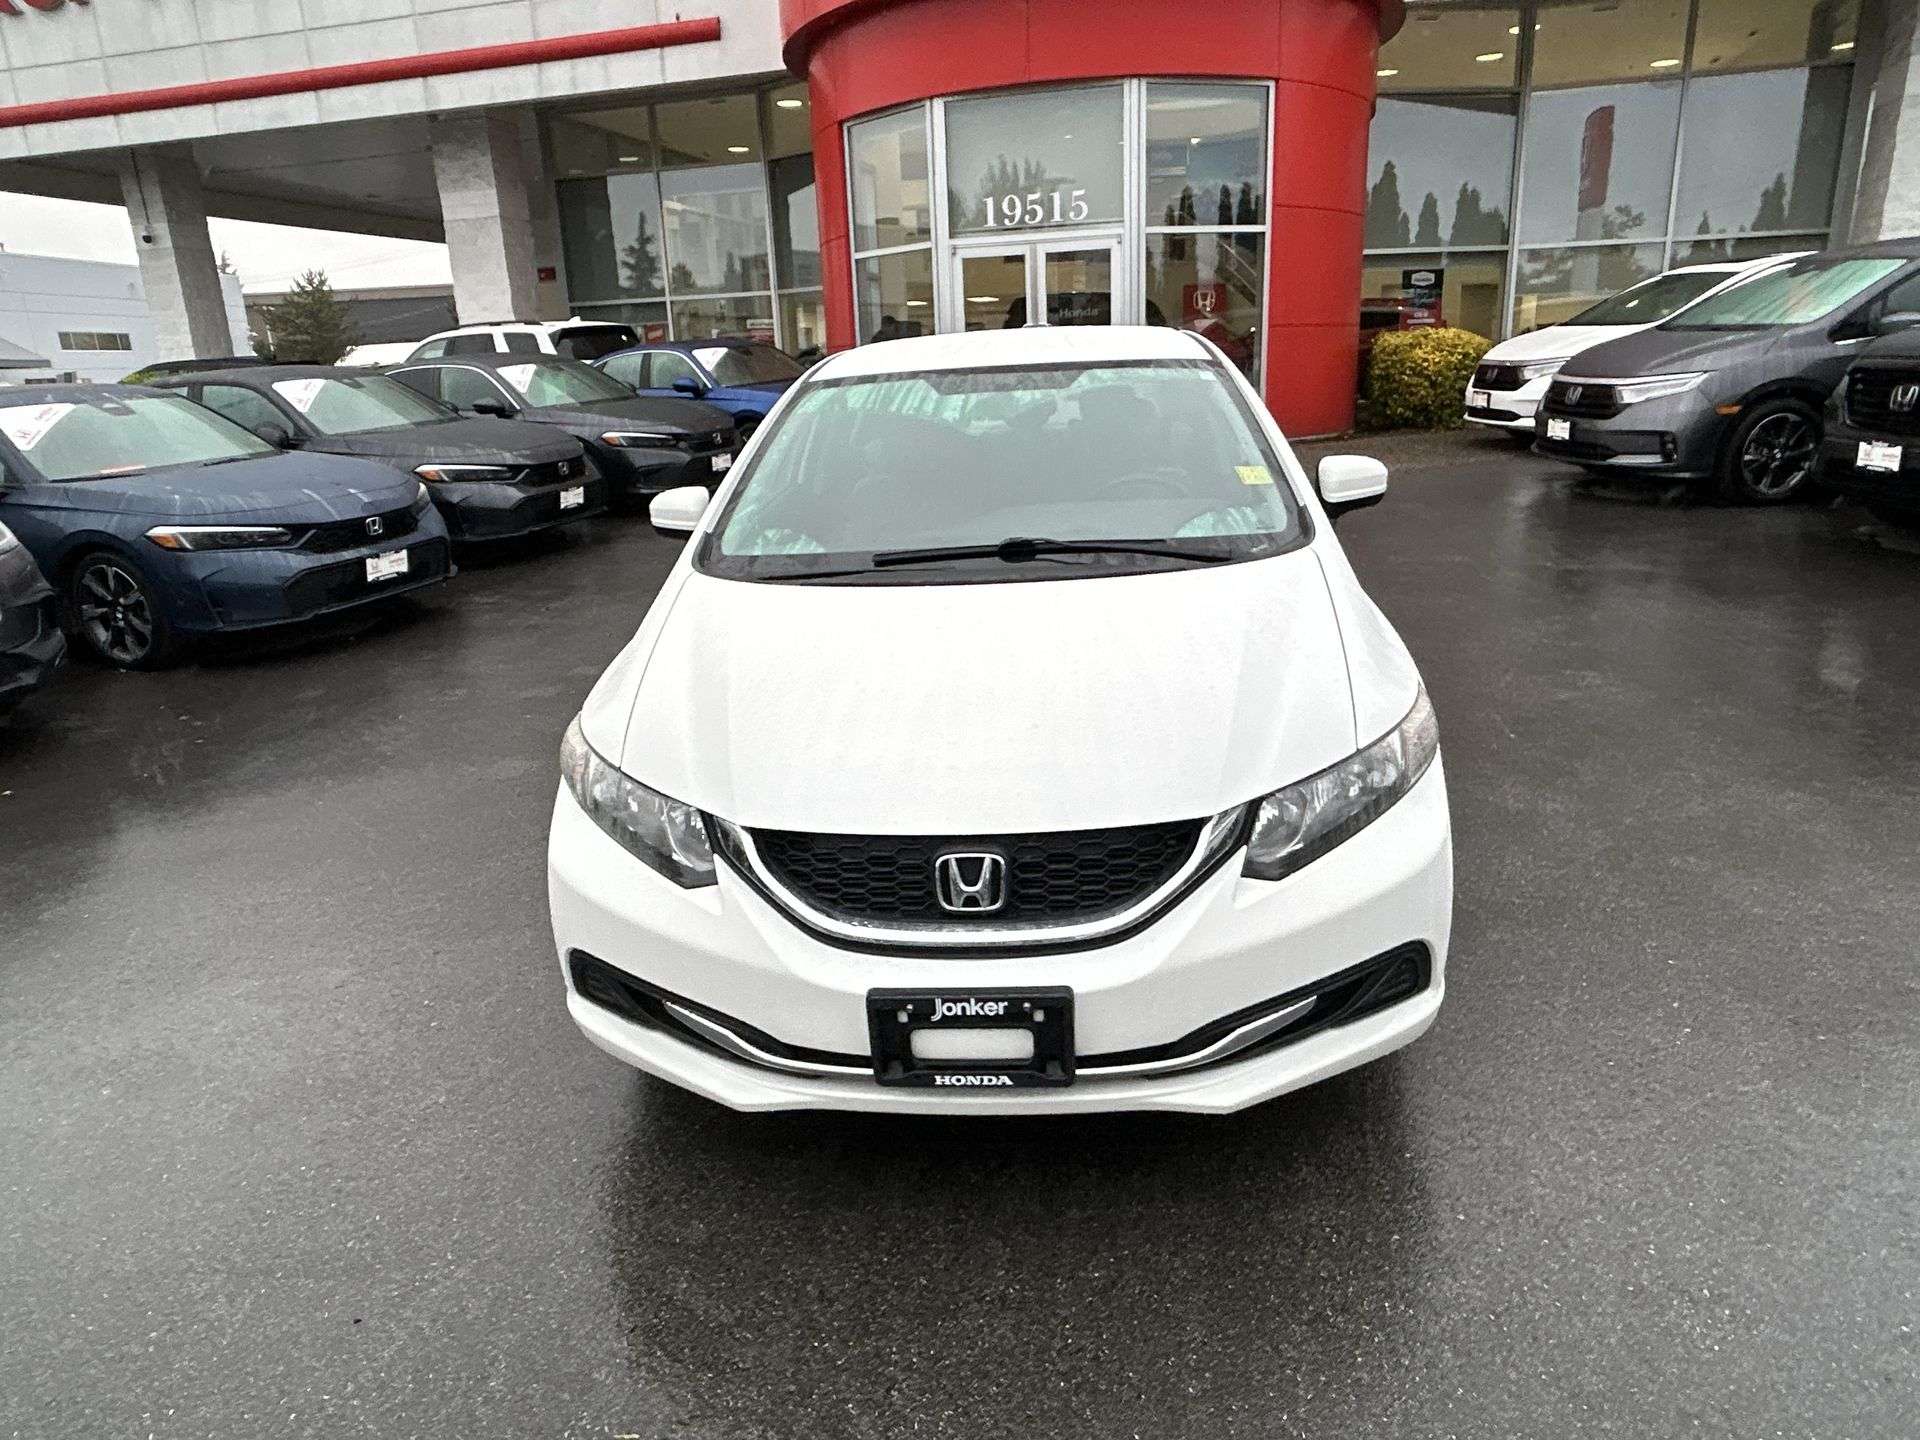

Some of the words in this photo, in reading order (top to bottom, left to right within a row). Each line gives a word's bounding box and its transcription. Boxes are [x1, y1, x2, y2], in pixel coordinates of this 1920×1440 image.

[983, 189, 1089, 227] 19515
[931, 998, 1008, 1021] Jonker
[933, 1075, 1014, 1086] HONDA
